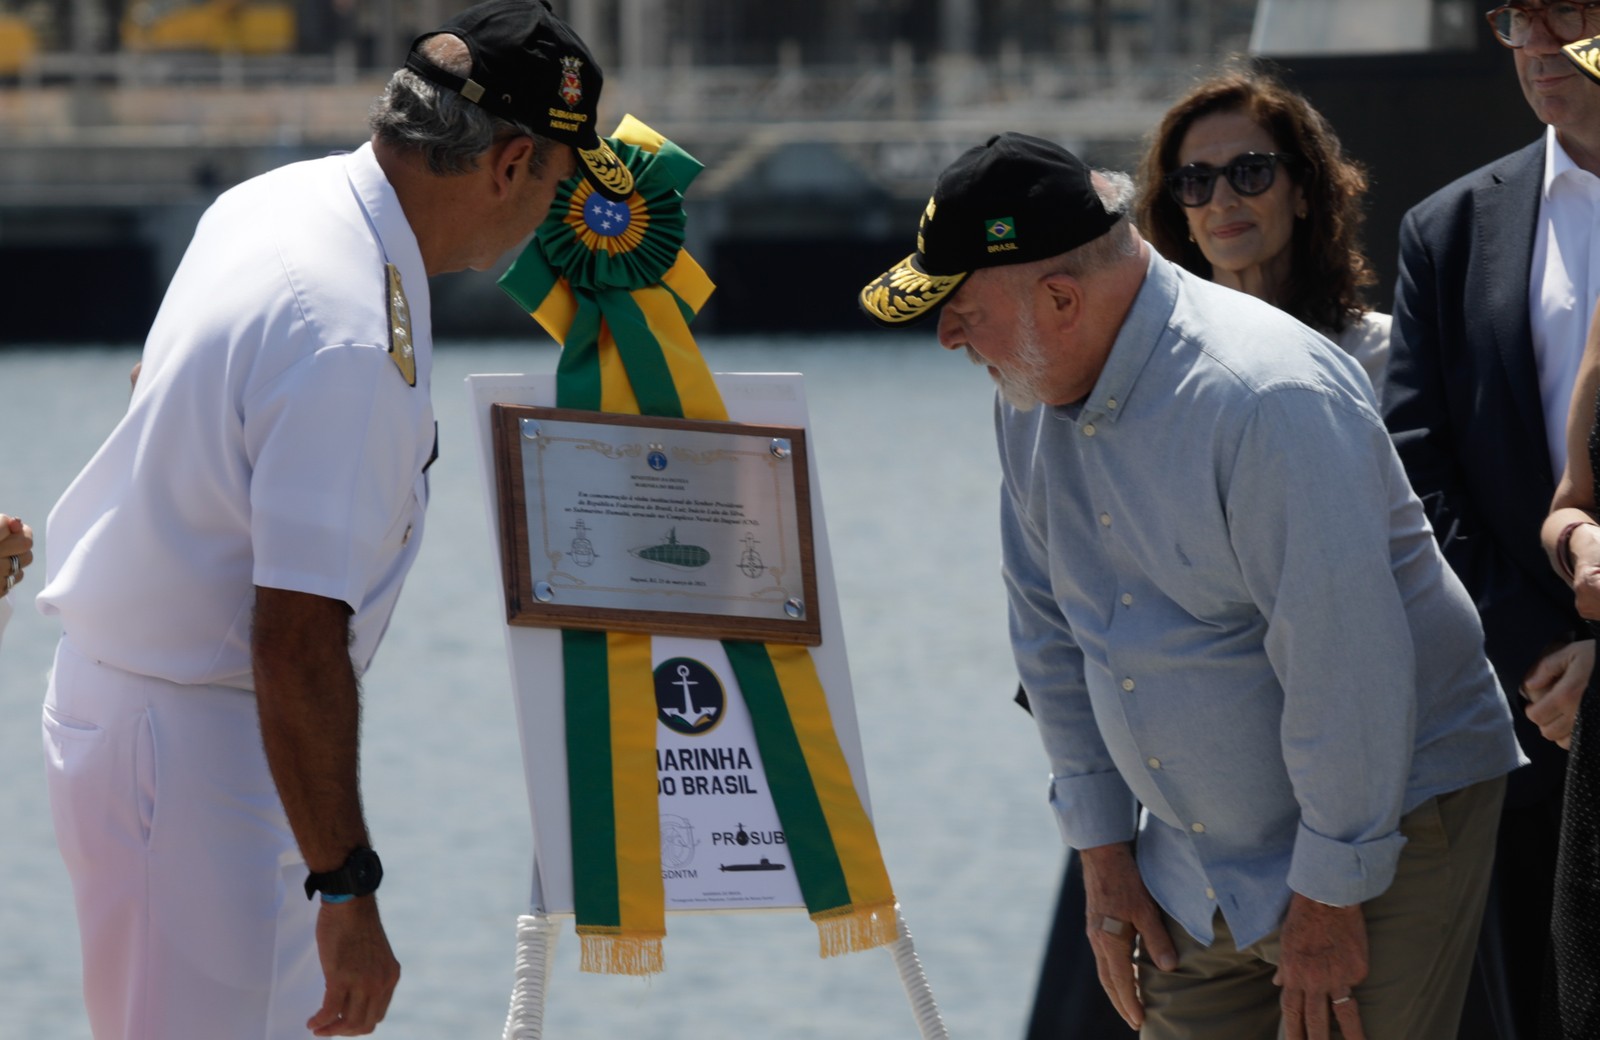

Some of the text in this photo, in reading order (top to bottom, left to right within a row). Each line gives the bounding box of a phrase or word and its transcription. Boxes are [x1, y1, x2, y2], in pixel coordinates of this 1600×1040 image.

[548, 107, 588, 123] SUBMARINO
[987, 242, 1019, 253] BRASIL
[615, 502, 645, 510] Federativa
[650, 497, 684, 505] institucional
[714, 501, 744, 509] Presidente
[666, 513, 694, 521] Complexo
[681, 775, 758, 795] BRASIL
[711, 831, 785, 846] PROSUB
